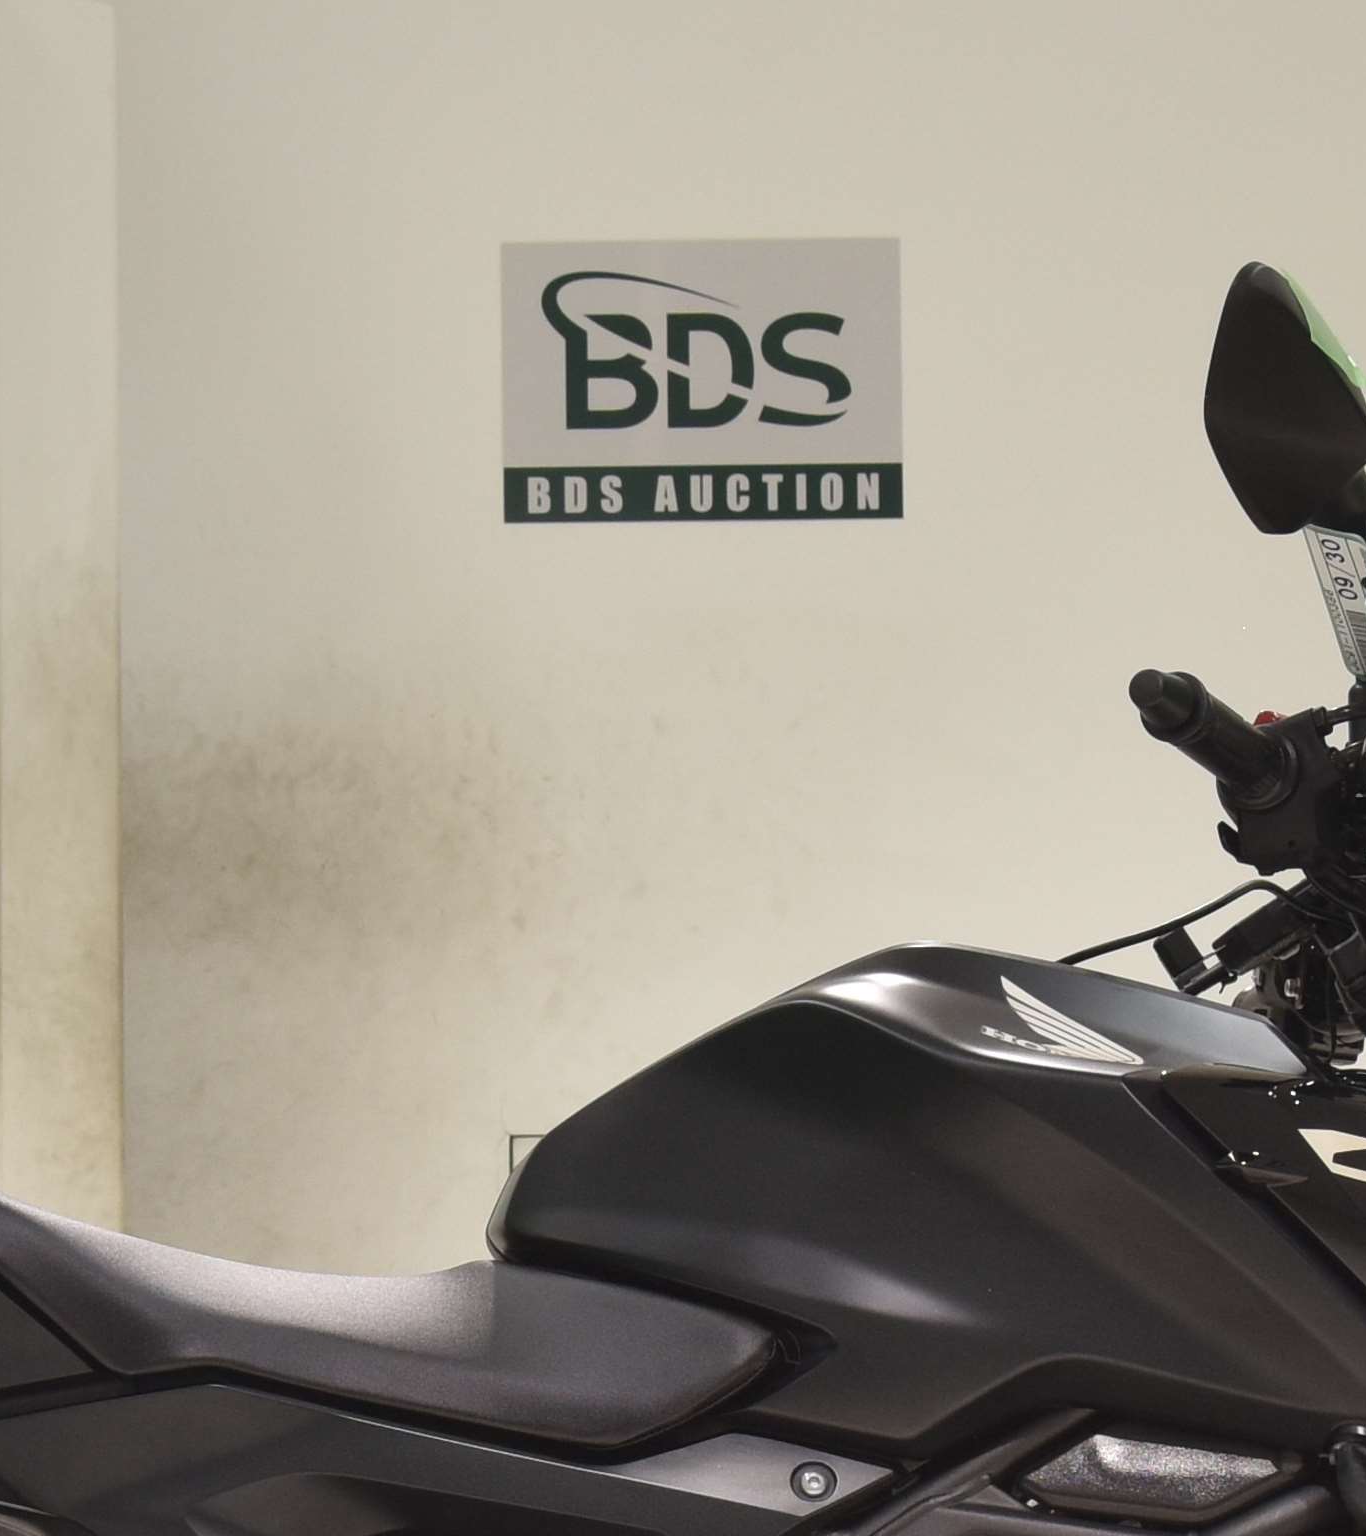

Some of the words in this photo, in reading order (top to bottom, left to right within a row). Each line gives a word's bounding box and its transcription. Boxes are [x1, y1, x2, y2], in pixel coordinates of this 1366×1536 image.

[541, 271, 852, 429] BDS
[527, 475, 623, 514] BDS
[654, 473, 880, 512] AUCTION
[1322, 538, 1358, 600] 09/30
